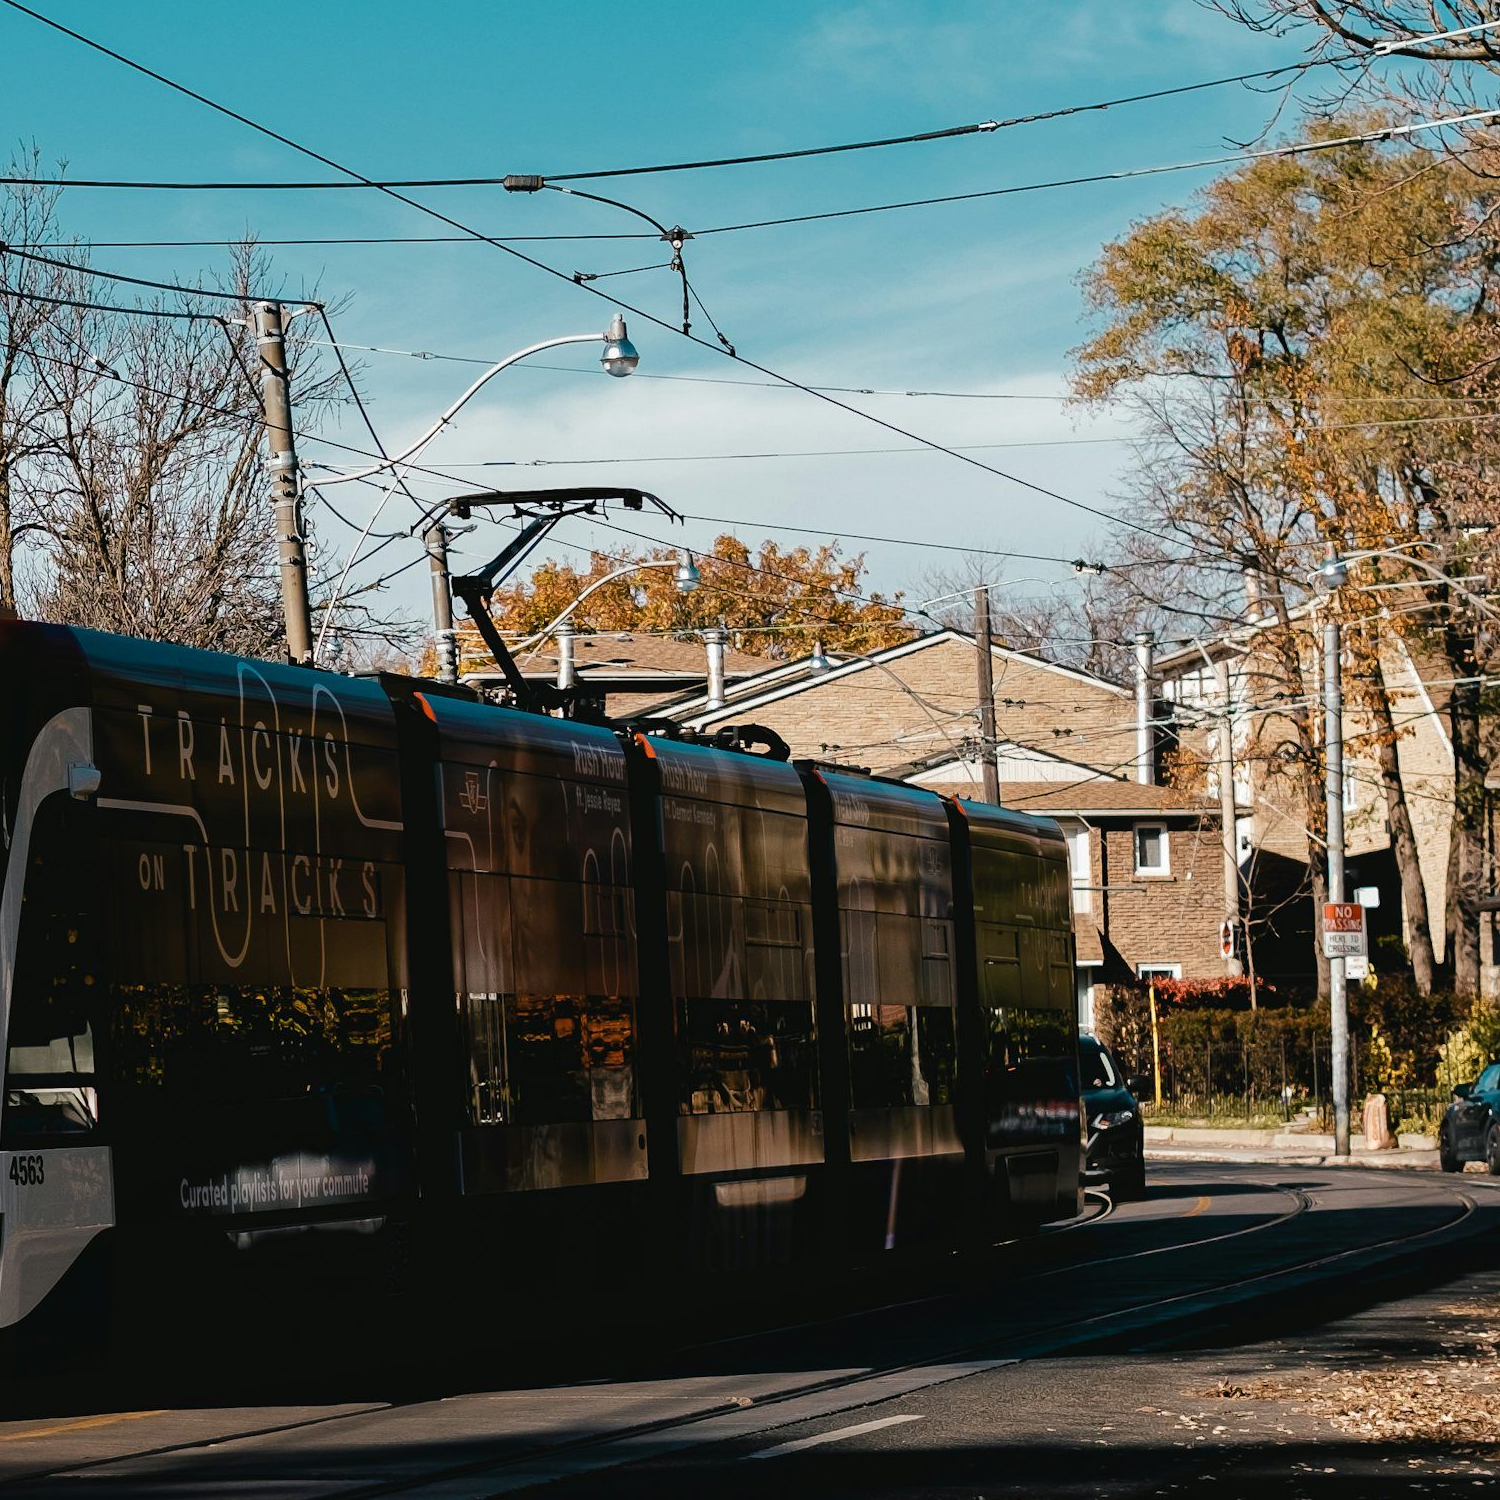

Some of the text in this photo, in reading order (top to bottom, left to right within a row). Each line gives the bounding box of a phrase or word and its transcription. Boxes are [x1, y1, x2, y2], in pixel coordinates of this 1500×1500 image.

[136, 704, 339, 799] TRACKS
[570, 740, 624, 780] Rush Hour
[683, 759, 707, 794] Hour
[576, 786, 622, 817] ft. Jessie Reyez
[139, 844, 377, 919] ON TRACKS
[1323, 918, 1362, 931] PASSING
[1335, 906, 1353, 918] NO
[1328, 944, 1361, 953] CROSSING
[1329, 934, 1359, 943] HERE TO
[9, 1155, 45, 1186] 4563
[180, 1167, 369, 1213] Curated playlists for your commute
